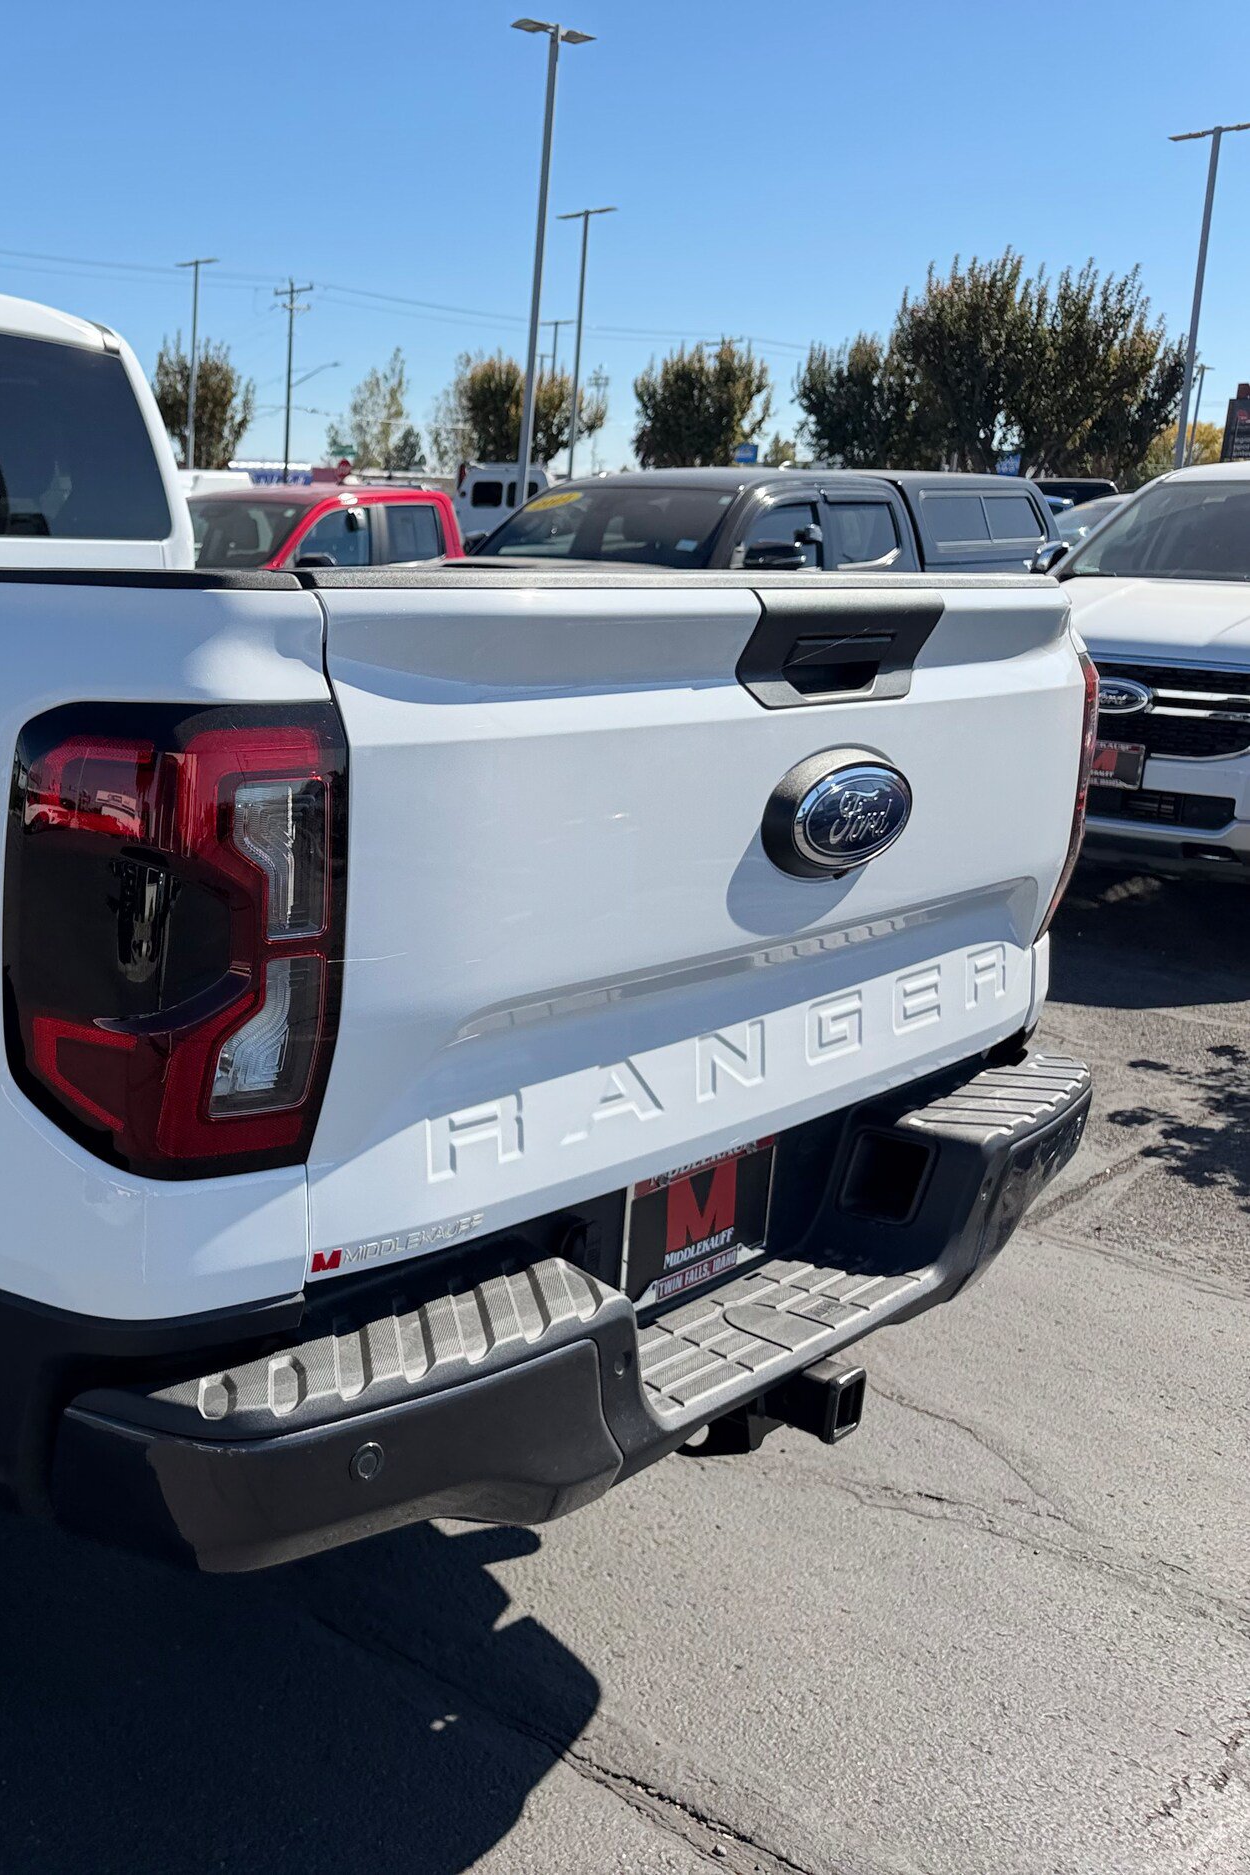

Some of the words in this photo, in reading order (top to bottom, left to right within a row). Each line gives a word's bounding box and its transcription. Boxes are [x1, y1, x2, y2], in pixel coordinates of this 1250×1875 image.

[829, 790, 892, 844] Ford
[425, 942, 1006, 1183] RANGER
[666, 1159, 737, 1253] M
[344, 1213, 484, 1264] MIDDLEKAUFF
[664, 1227, 734, 1269] MIDDLEKAUFF
[659, 1276, 683, 1298] TWIN
[713, 1251, 737, 1273] IDAHO
